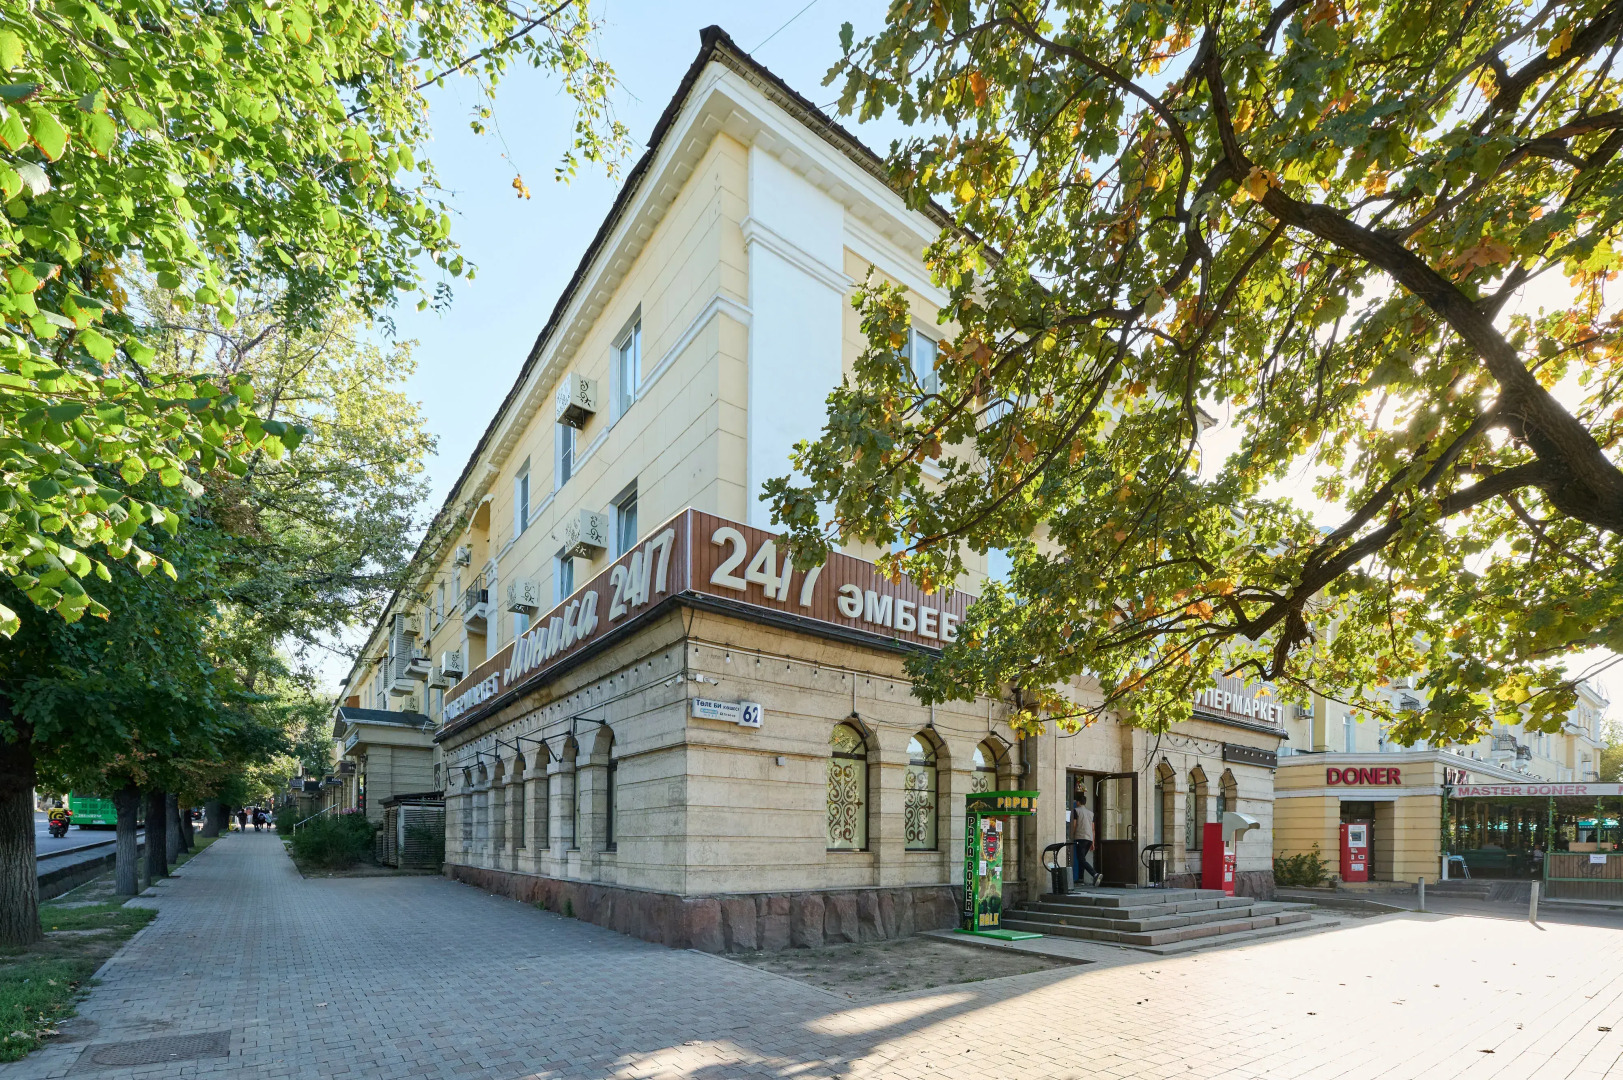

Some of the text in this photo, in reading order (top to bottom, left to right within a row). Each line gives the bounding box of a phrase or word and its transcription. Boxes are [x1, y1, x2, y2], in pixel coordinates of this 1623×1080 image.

[710, 526, 829, 607] 24/7
[837, 583, 960, 644] ӘМБЕБ
[503, 590, 599, 687] Моника
[608, 528, 675, 622] 24/7
[743, 705, 759, 724] 62
[1195, 687, 1283, 724] УПЕРМАРКЕТ
[1326, 767, 1402, 785] DONER
[1458, 784, 1588, 796] MASTER DONER
[997, 796, 1029, 809] PAPA
[967, 816, 976, 858] PAPA
[965, 861, 974, 911] BOXER
